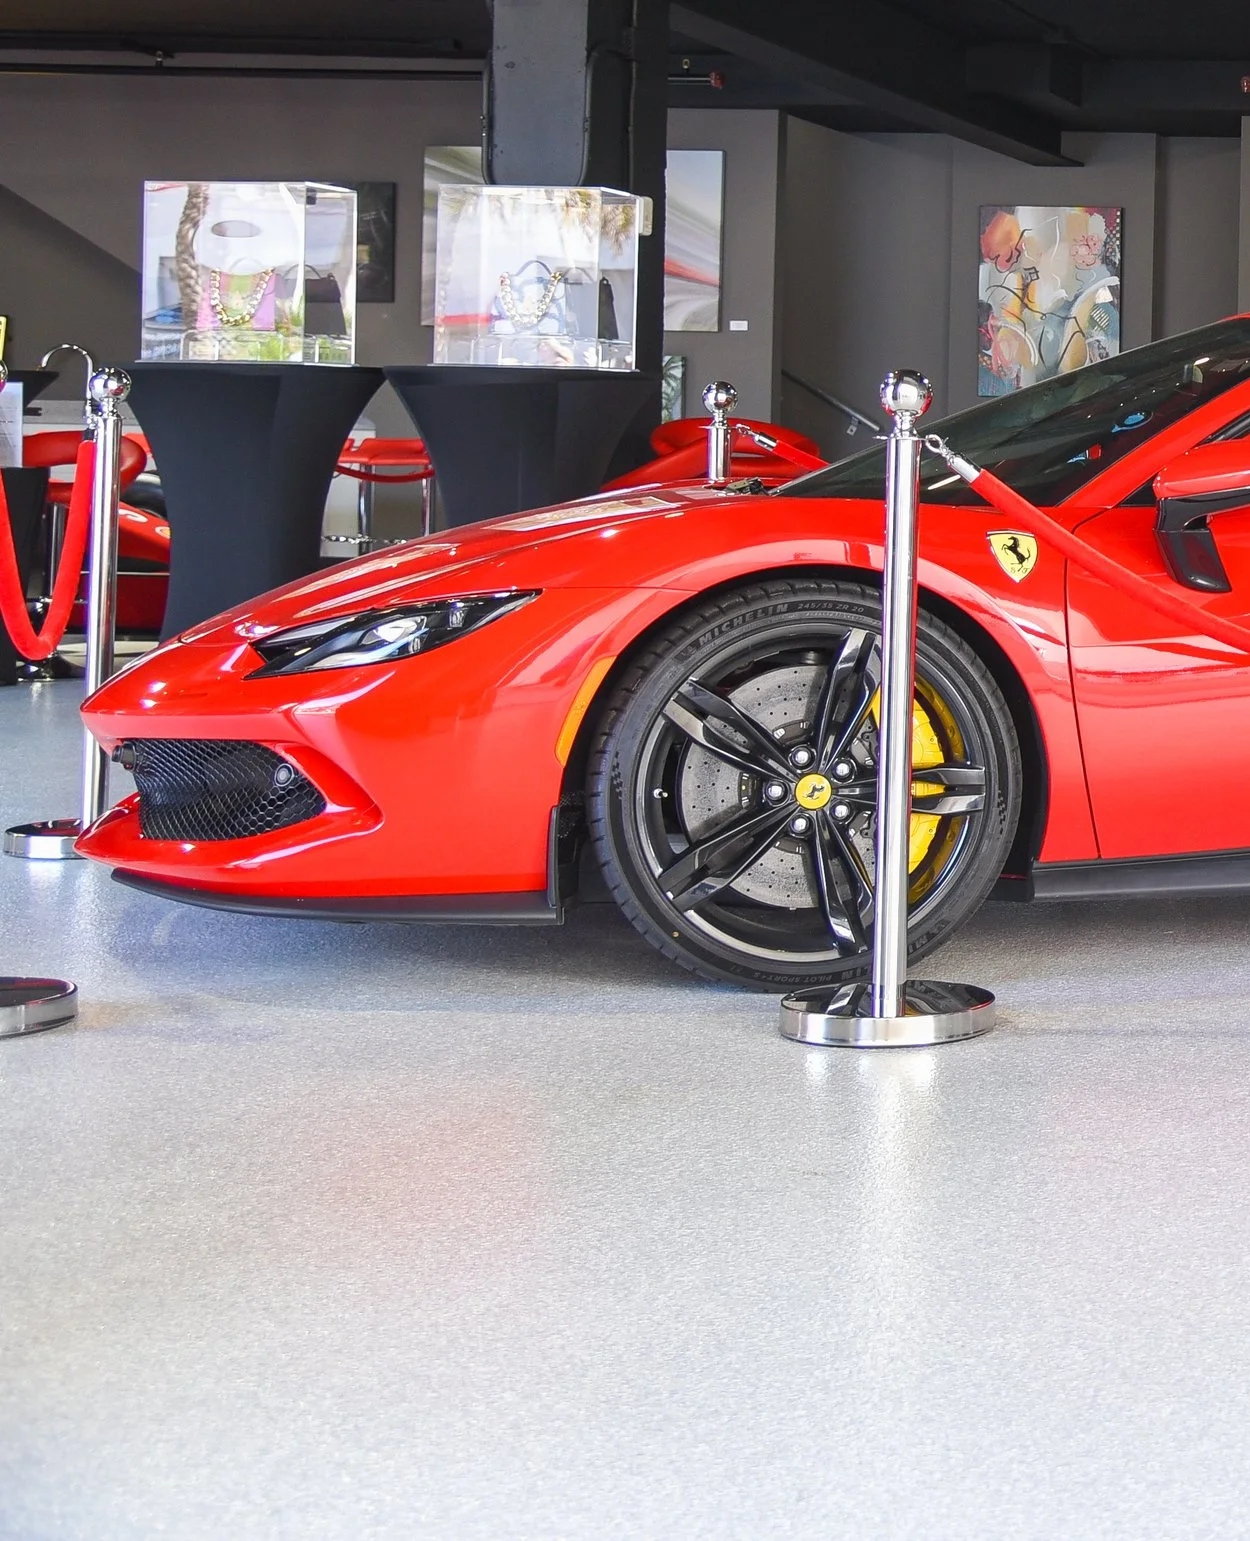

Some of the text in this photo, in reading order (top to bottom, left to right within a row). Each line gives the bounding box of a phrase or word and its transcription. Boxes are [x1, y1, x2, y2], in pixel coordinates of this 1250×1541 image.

[698, 601, 865, 646] MICHELIN 245/35 ZR 20
